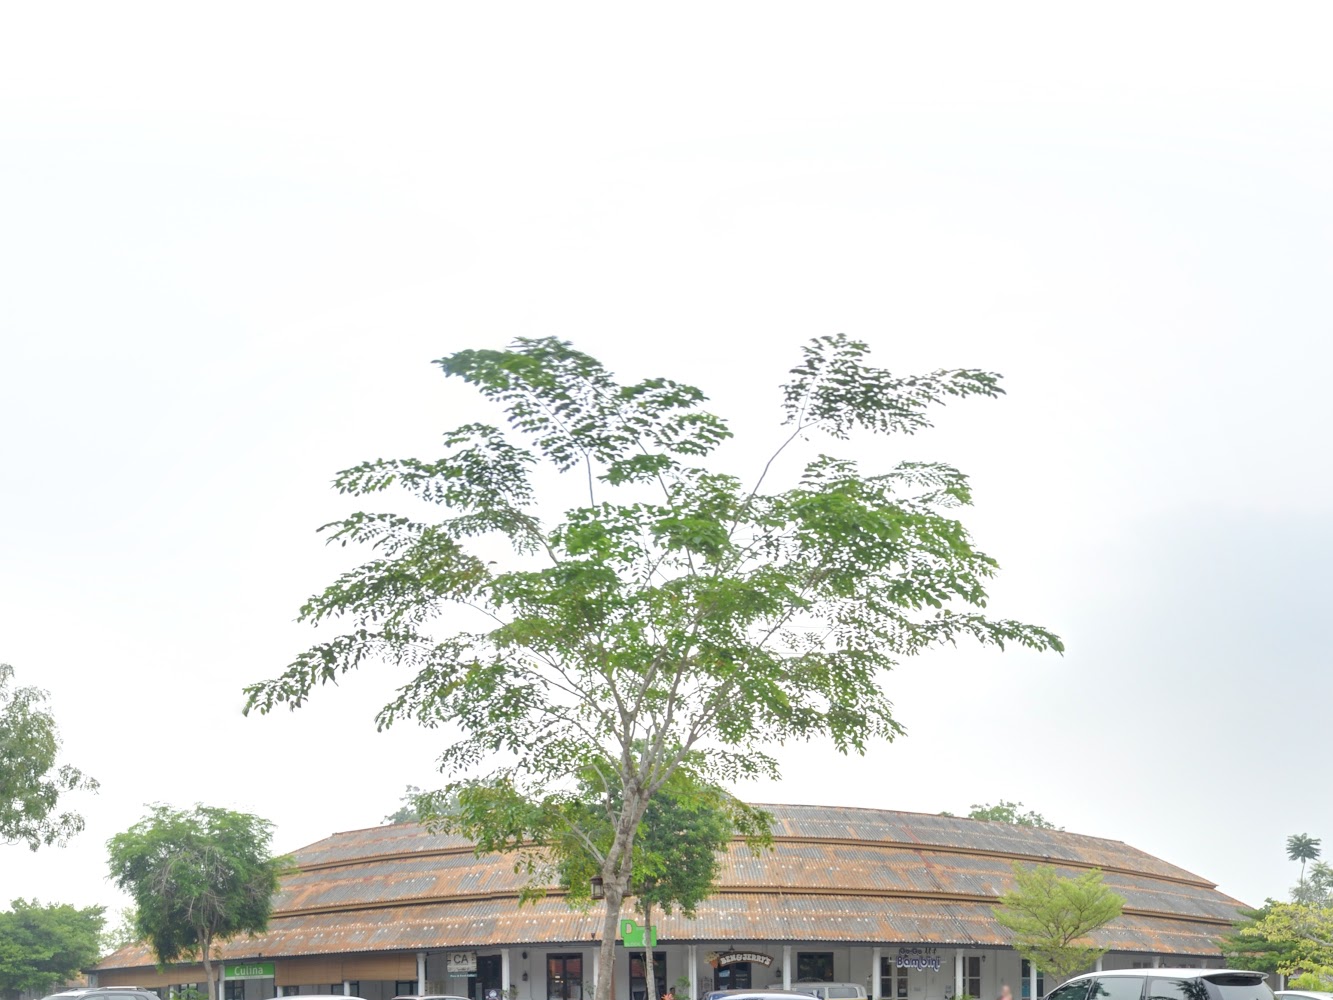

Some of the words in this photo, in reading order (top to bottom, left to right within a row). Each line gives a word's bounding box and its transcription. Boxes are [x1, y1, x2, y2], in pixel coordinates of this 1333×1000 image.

[453, 954, 469, 964] CA
[896, 956, 941, 972] Bambini
[234, 966, 264, 976] Culina
